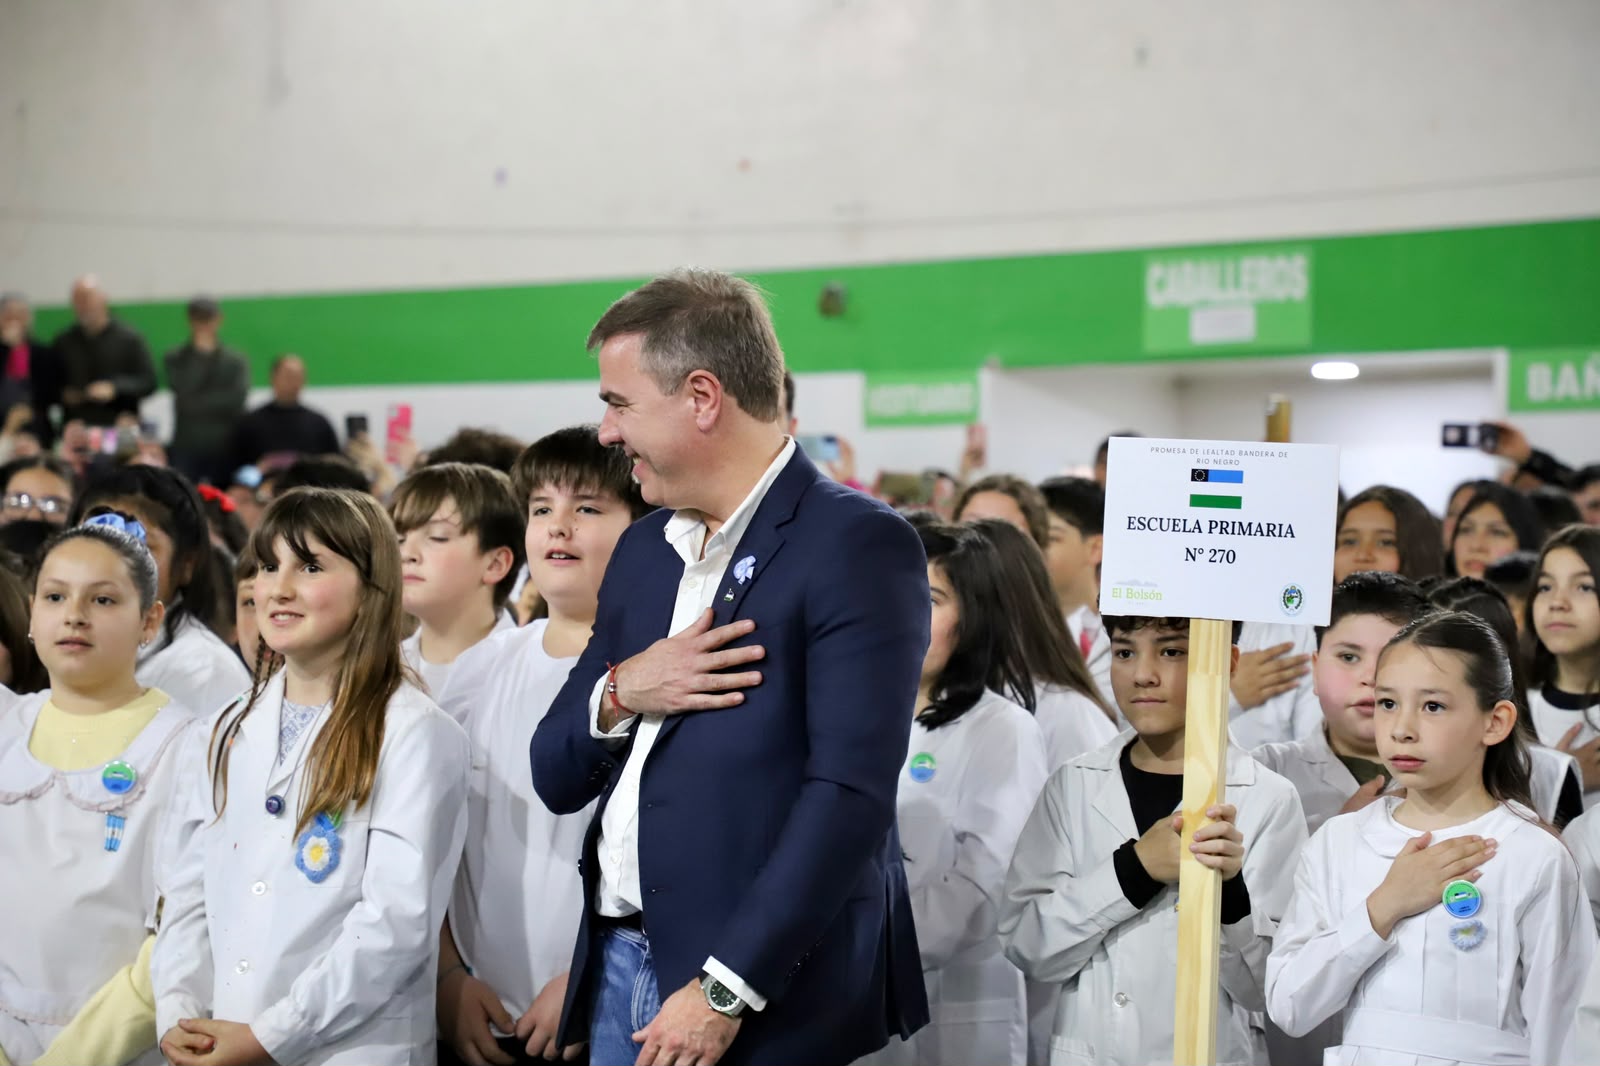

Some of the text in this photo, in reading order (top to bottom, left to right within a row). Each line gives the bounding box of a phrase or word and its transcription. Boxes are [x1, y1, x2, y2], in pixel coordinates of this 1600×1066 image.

[1238, 450, 1275, 458] BANDERA
[1126, 516, 1296, 538] ESCUELA PRIMARIA
[1184, 547, 1236, 564] N° 270
[1111, 587, 1163, 601] El Bolsón
